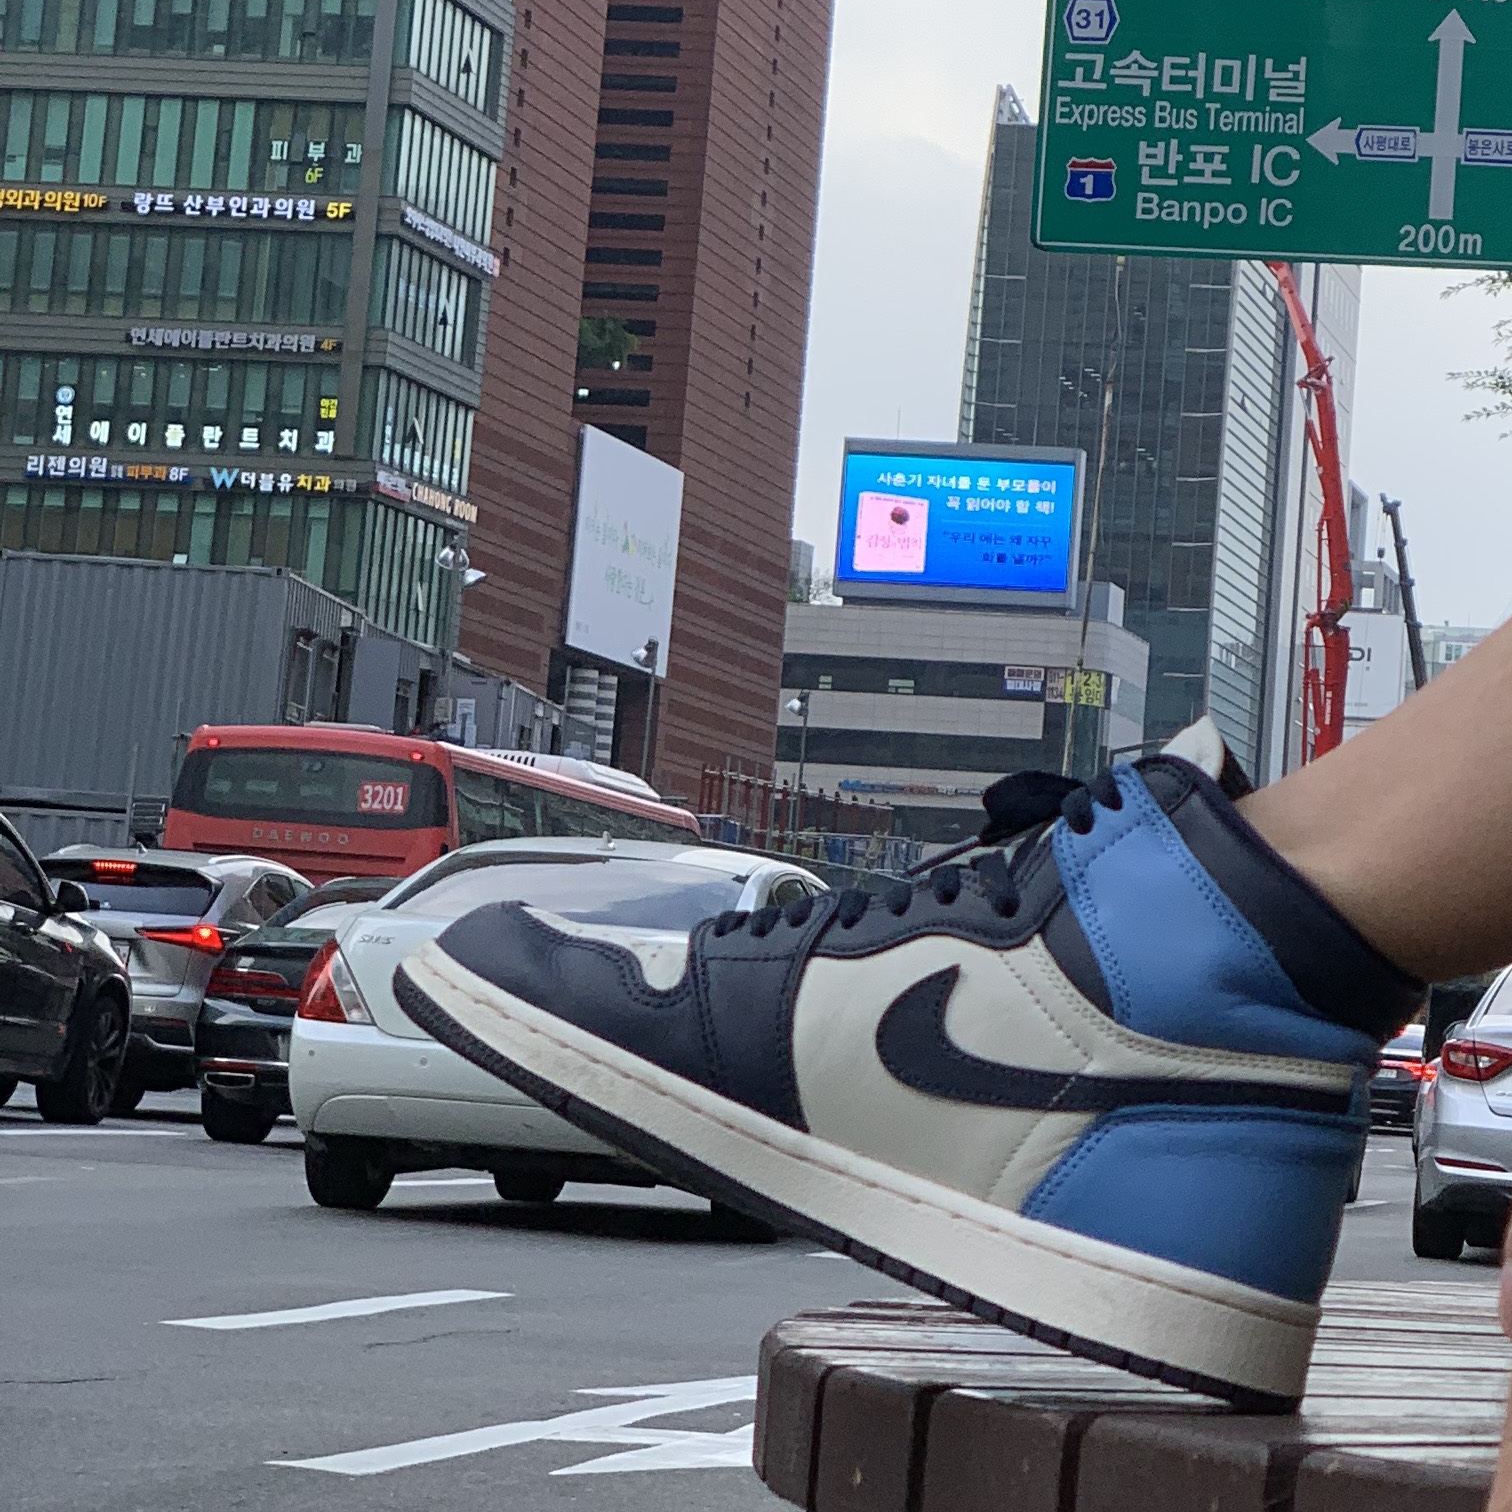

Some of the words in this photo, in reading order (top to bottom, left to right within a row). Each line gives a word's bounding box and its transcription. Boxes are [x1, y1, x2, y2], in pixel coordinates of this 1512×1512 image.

[1075, 9, 1106, 29] 31
[1057, 50, 1307, 103] 고속터미널
[1055, 96, 1146, 131] Express
[1154, 100, 1198, 130] Bus
[1205, 102, 1305, 134] Terminal
[1363, 134, 1412, 153] 사평대로
[1137, 138, 1232, 186] 반포
[1250, 144, 1301, 187] IC
[305, 167, 324, 184] 6F
[1079, 173, 1094, 195] 1
[184, 194, 316, 221] 산부인과의원
[326, 201, 353, 219] 5F
[1135, 192, 1248, 229] Banpo
[1259, 198, 1293, 227] IC
[1398, 224, 1483, 256] 200m
[320, 338, 339, 352] 4F
[27, 454, 107, 479] 리젠의원
[168, 466, 189, 482] 8F
[877, 472, 922, 488] 사춘기
[966, 497, 1012, 513] 읽어야
[360, 784, 404, 810] 3201
[252, 827, 349, 845] DAEWOO
